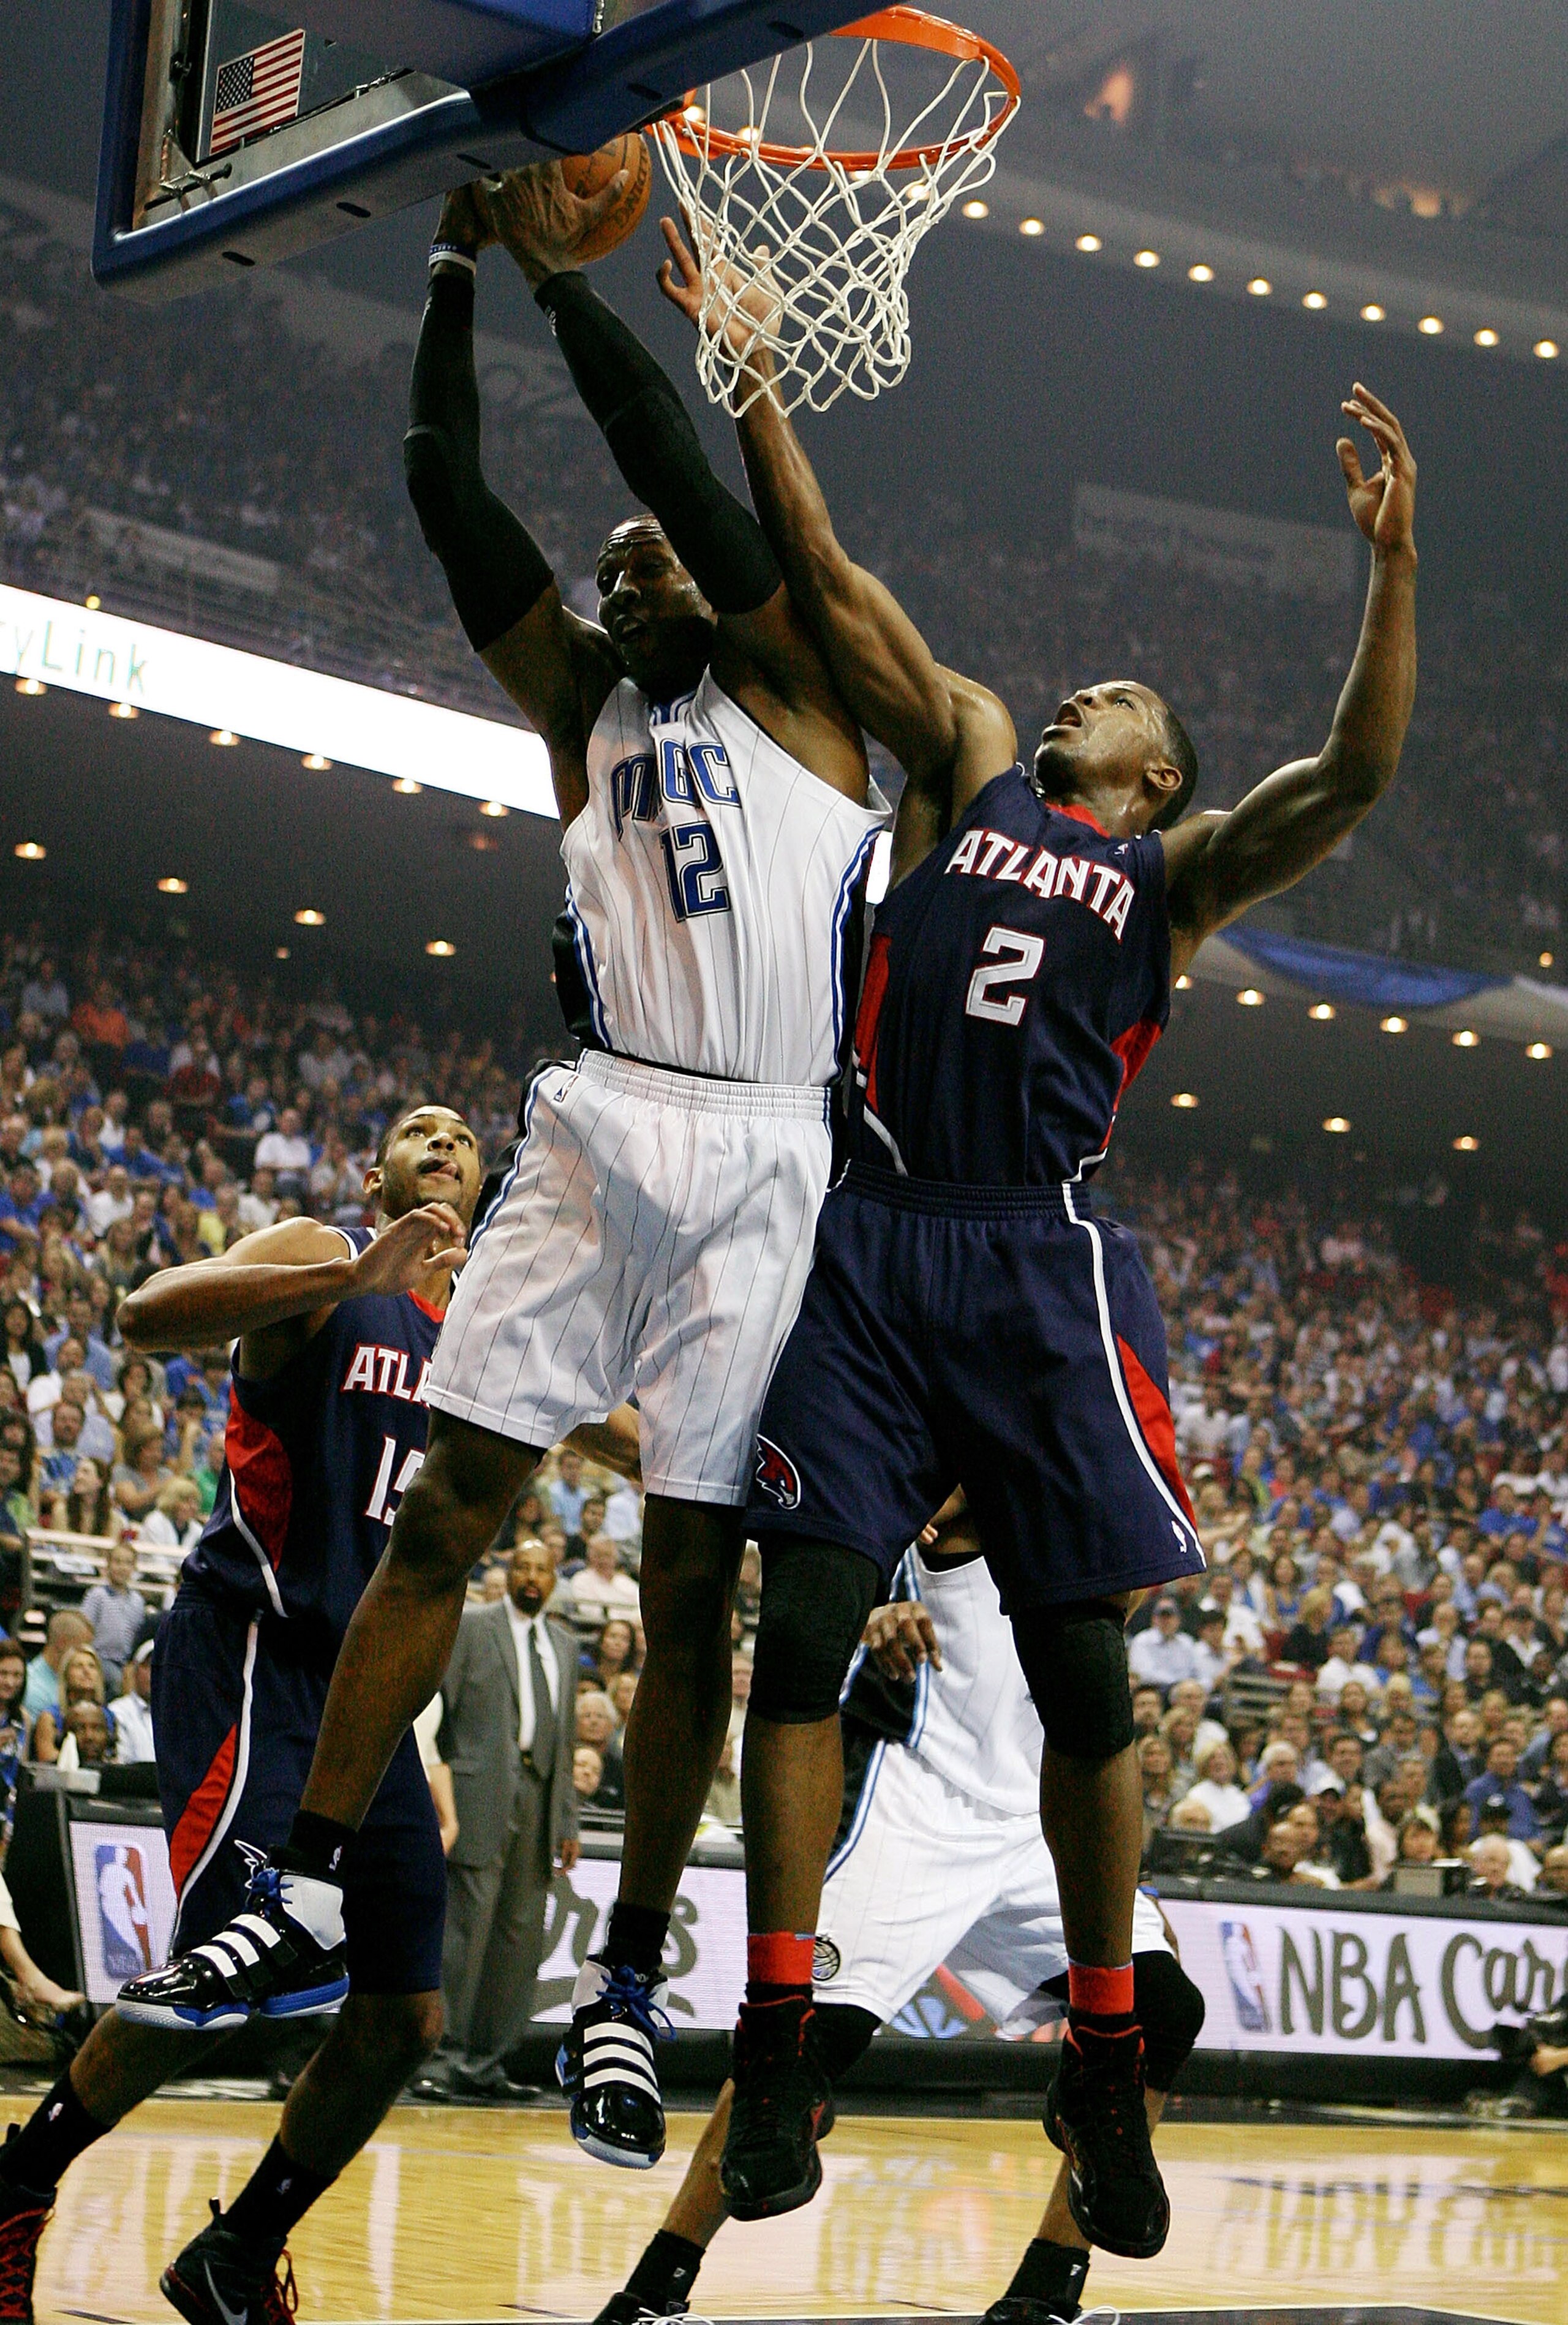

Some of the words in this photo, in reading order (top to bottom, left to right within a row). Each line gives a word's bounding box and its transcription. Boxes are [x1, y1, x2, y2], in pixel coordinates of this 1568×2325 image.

[0, 619, 147, 695] yLink
[658, 820, 731, 923] 12
[943, 828, 1135, 944] ATLANTA
[966, 925, 1044, 1026] 2
[341, 1343, 434, 1408] ATLA
[1278, 1926, 1426, 2043] NBA
[1441, 1932, 1568, 2049] Car
